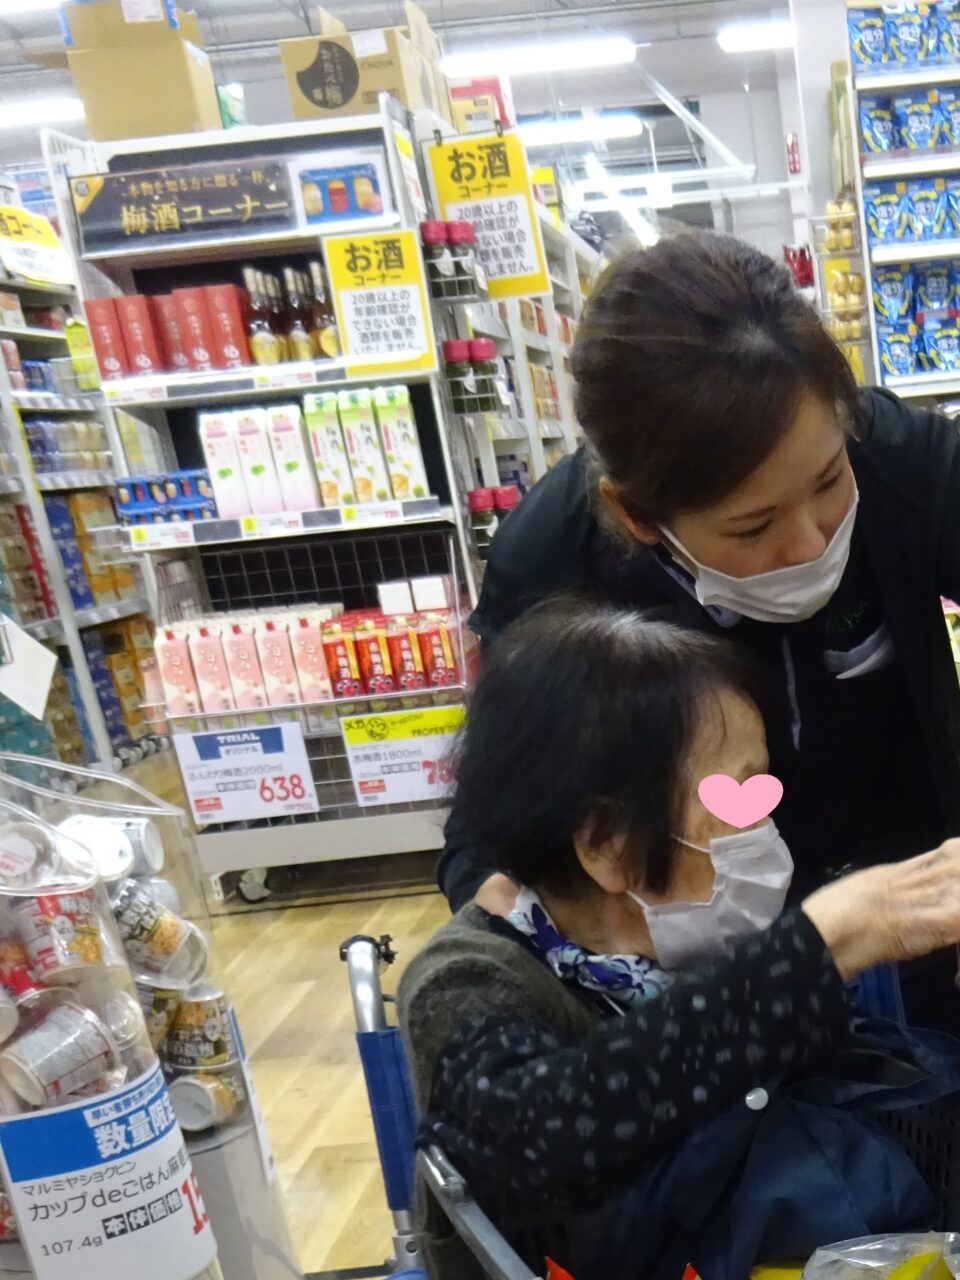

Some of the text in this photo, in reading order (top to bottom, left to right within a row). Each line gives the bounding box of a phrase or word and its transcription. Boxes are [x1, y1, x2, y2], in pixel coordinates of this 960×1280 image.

[448, 141, 511, 183] お酒
[458, 181, 508, 198] コーナー
[120, 193, 288, 235] 梅酒コーナー
[458, 200, 518, 219] 20歳以上の
[344, 238, 404, 273] お酒
[353, 273, 403, 287] コーナー
[351, 289, 411, 305] 20歳以上の
[353, 302, 411, 317] 年齢確認が
[352, 314, 417, 331] できない場合
[360, 327, 415, 343] 酒類を販売
[216, 732, 260, 744] TRIAL
[259, 774, 306, 803] 638
[21, 1160, 137, 1197] マルミヤショクヒン
[102, 1187, 184, 1240] 本体価格
[181, 1170, 208, 1236] 1
[40, 1233, 104, 1257] 107.4g
